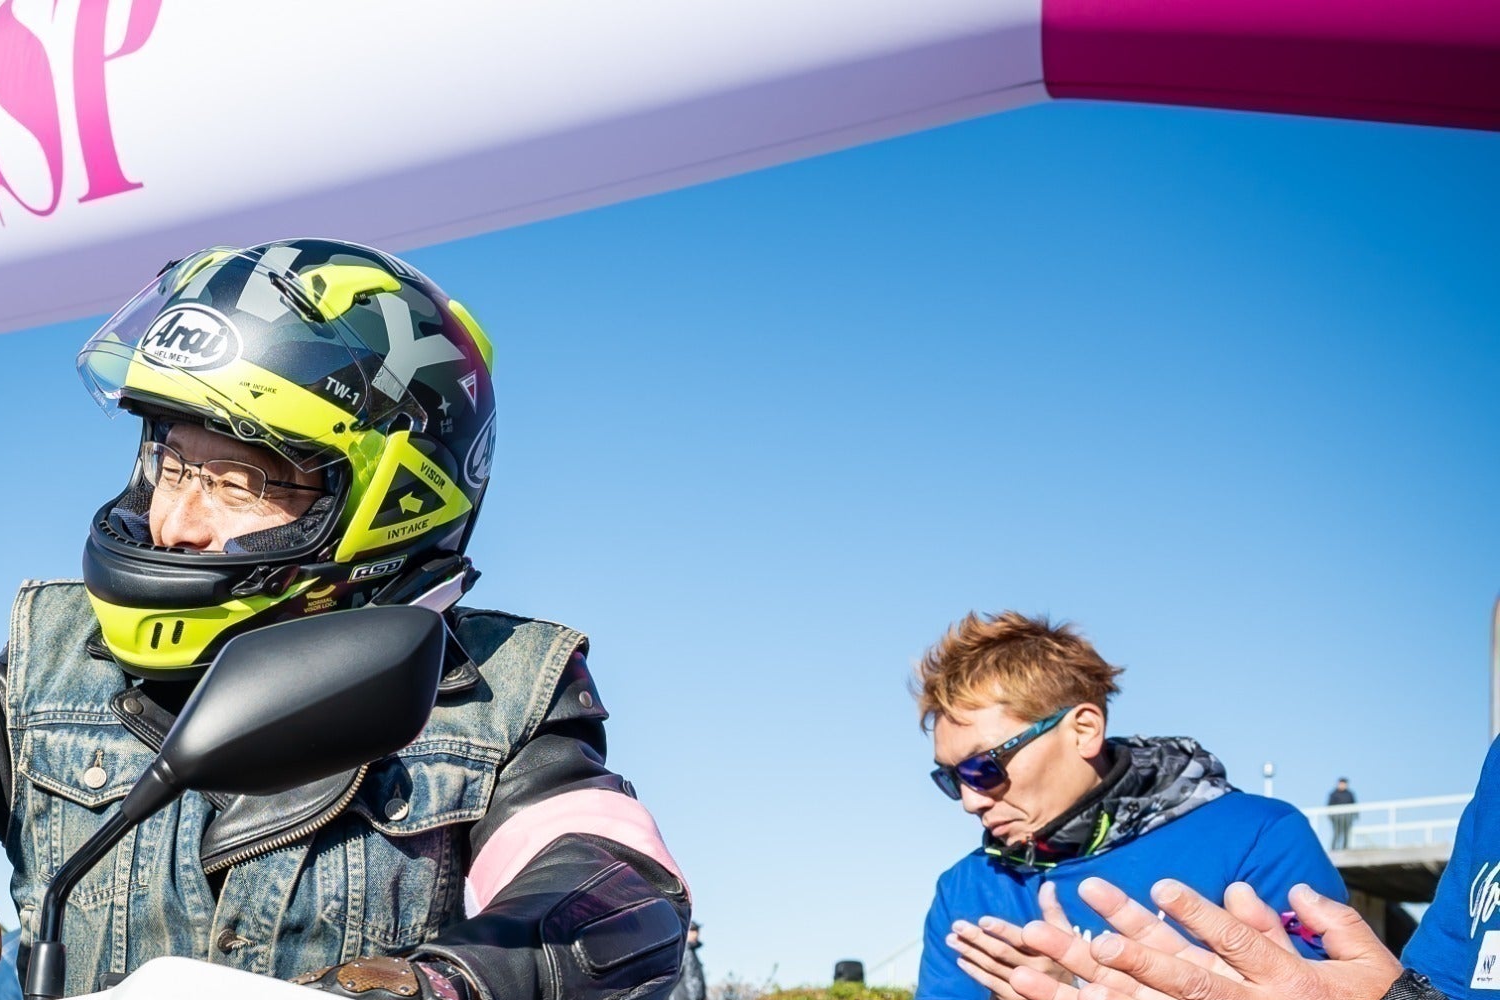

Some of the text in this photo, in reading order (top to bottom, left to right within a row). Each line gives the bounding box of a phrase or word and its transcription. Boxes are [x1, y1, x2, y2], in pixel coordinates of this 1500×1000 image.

[142, 312, 228, 358] Arai
[154, 349, 190, 364] HELMET
[325, 376, 360, 406] TW-1
[420, 461, 446, 490] VISOR
[387, 519, 430, 540] INTAKE
